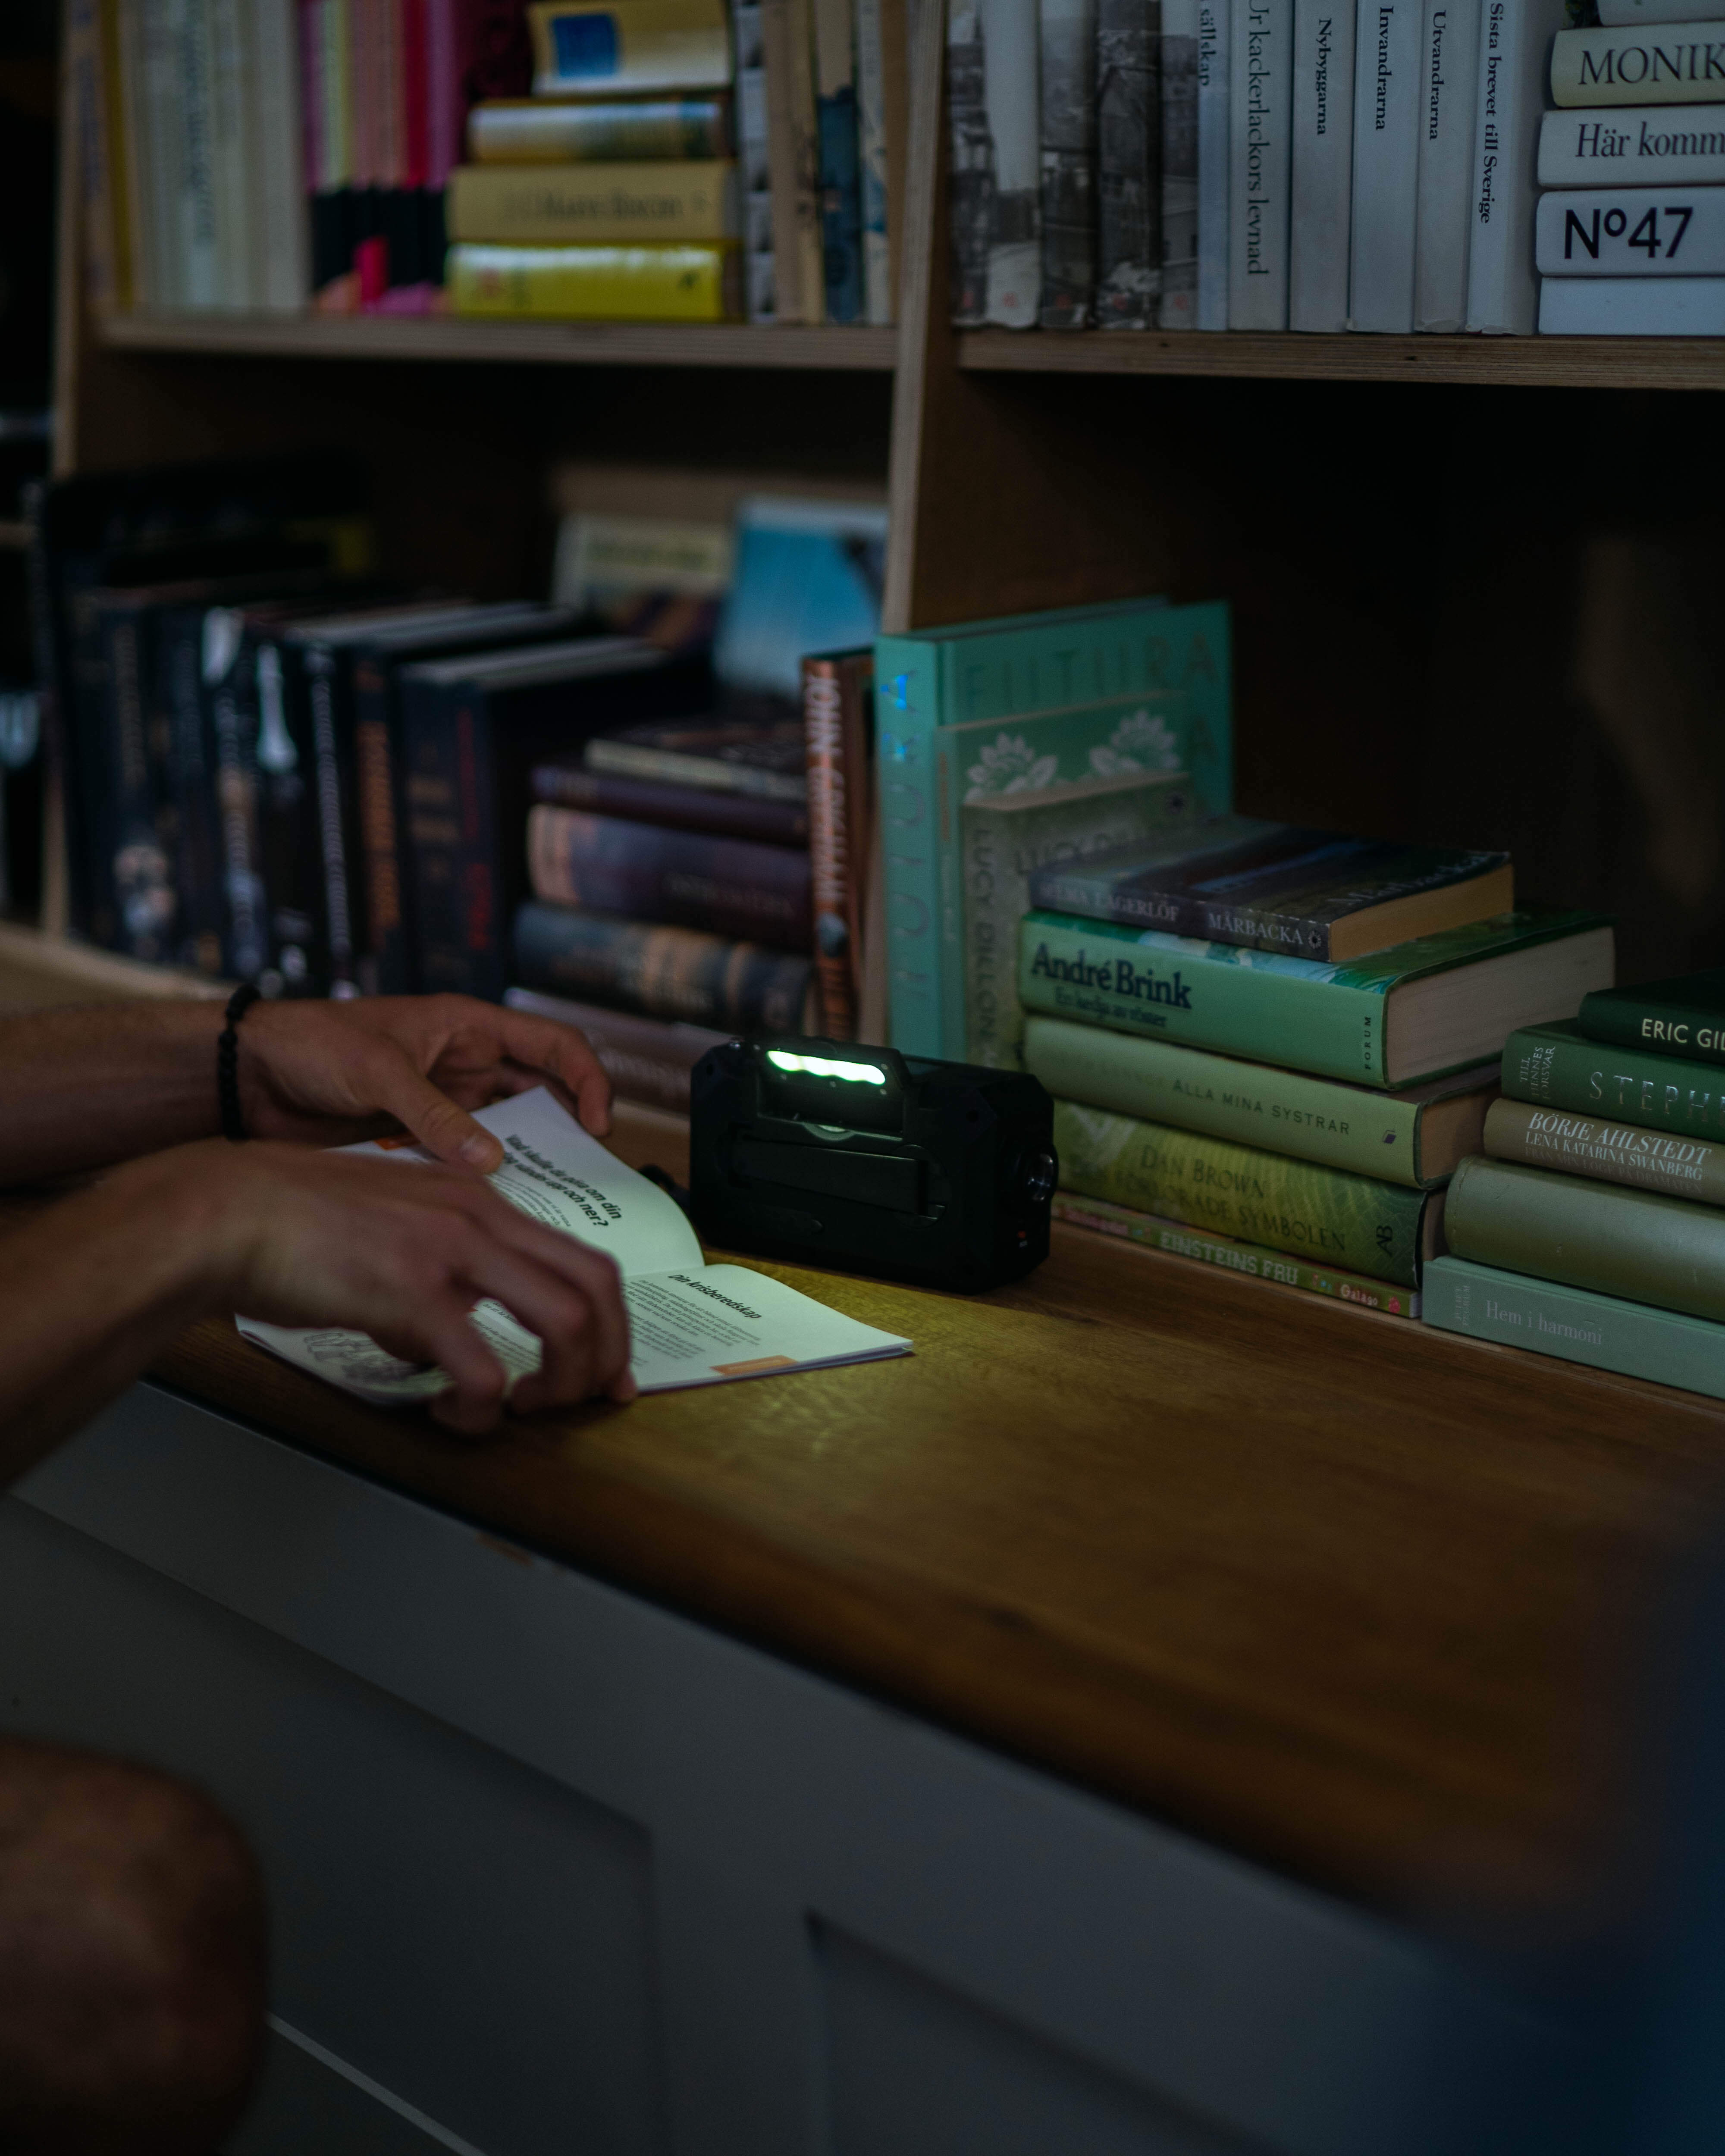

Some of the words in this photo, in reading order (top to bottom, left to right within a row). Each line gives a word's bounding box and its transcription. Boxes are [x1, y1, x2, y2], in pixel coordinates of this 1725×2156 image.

[1489, 3, 1504, 50] Sista
[1316, 18, 1332, 135] Nybyggarna
[1376, 6, 1393, 131] Invandrarna
[1429, 10, 1446, 140] Utvandrarna
[1486, 56, 1502, 116] brevet
[1578, 44, 1725, 85] MONIK
[1248, 29, 1270, 191] kackerlackors
[1484, 124, 1498, 151] till
[1576, 123, 1630, 157] Här
[1638, 121, 1725, 156] komm
[1479, 156, 1497, 224] Sverige
[1248, 199, 1269, 274] levnad
[1208, 911, 1304, 946] MÅRBACKA
[1032, 943, 1112, 990] André
[1115, 959, 1192, 1009] Brink
[1642, 1018, 1688, 1044] ERIC
[1520, 1057, 1531, 1082] TILL
[1173, 1078, 1214, 1100] ALLA
[1222, 1093, 1264, 1115] MINA
[1273, 1105, 1350, 1136] SYSTRAR
[1525, 1131, 1559, 1150] LENA
[1563, 1139, 1625, 1164] KATARINA
[1628, 1153, 1703, 1181] SWANBERG
[1527, 1112, 1594, 1141] BÖRJE
[1595, 1128, 1712, 1165] AHLSTEDT
[1193, 1159, 1264, 1198] BROWN
[564, 1190, 587, 1203] och
[580, 1203, 608, 1226] ner?
[585, 1188, 606, 1201] om
[601, 1203, 622, 1219] din
[1239, 1206, 1345, 1251] SYMBOLEN
[1160, 1232, 1258, 1274] EINSTEINS
[1263, 1260, 1298, 1285] FRU
[1340, 1284, 1377, 1307] Galago
[668, 1274, 691, 1282] Din
[688, 1282, 762, 1319] krisberedskap
[1487, 1300, 1522, 1326] Hem
[1528, 1311, 1532, 1328] i
[1538, 1313, 1602, 1345] harmoni
